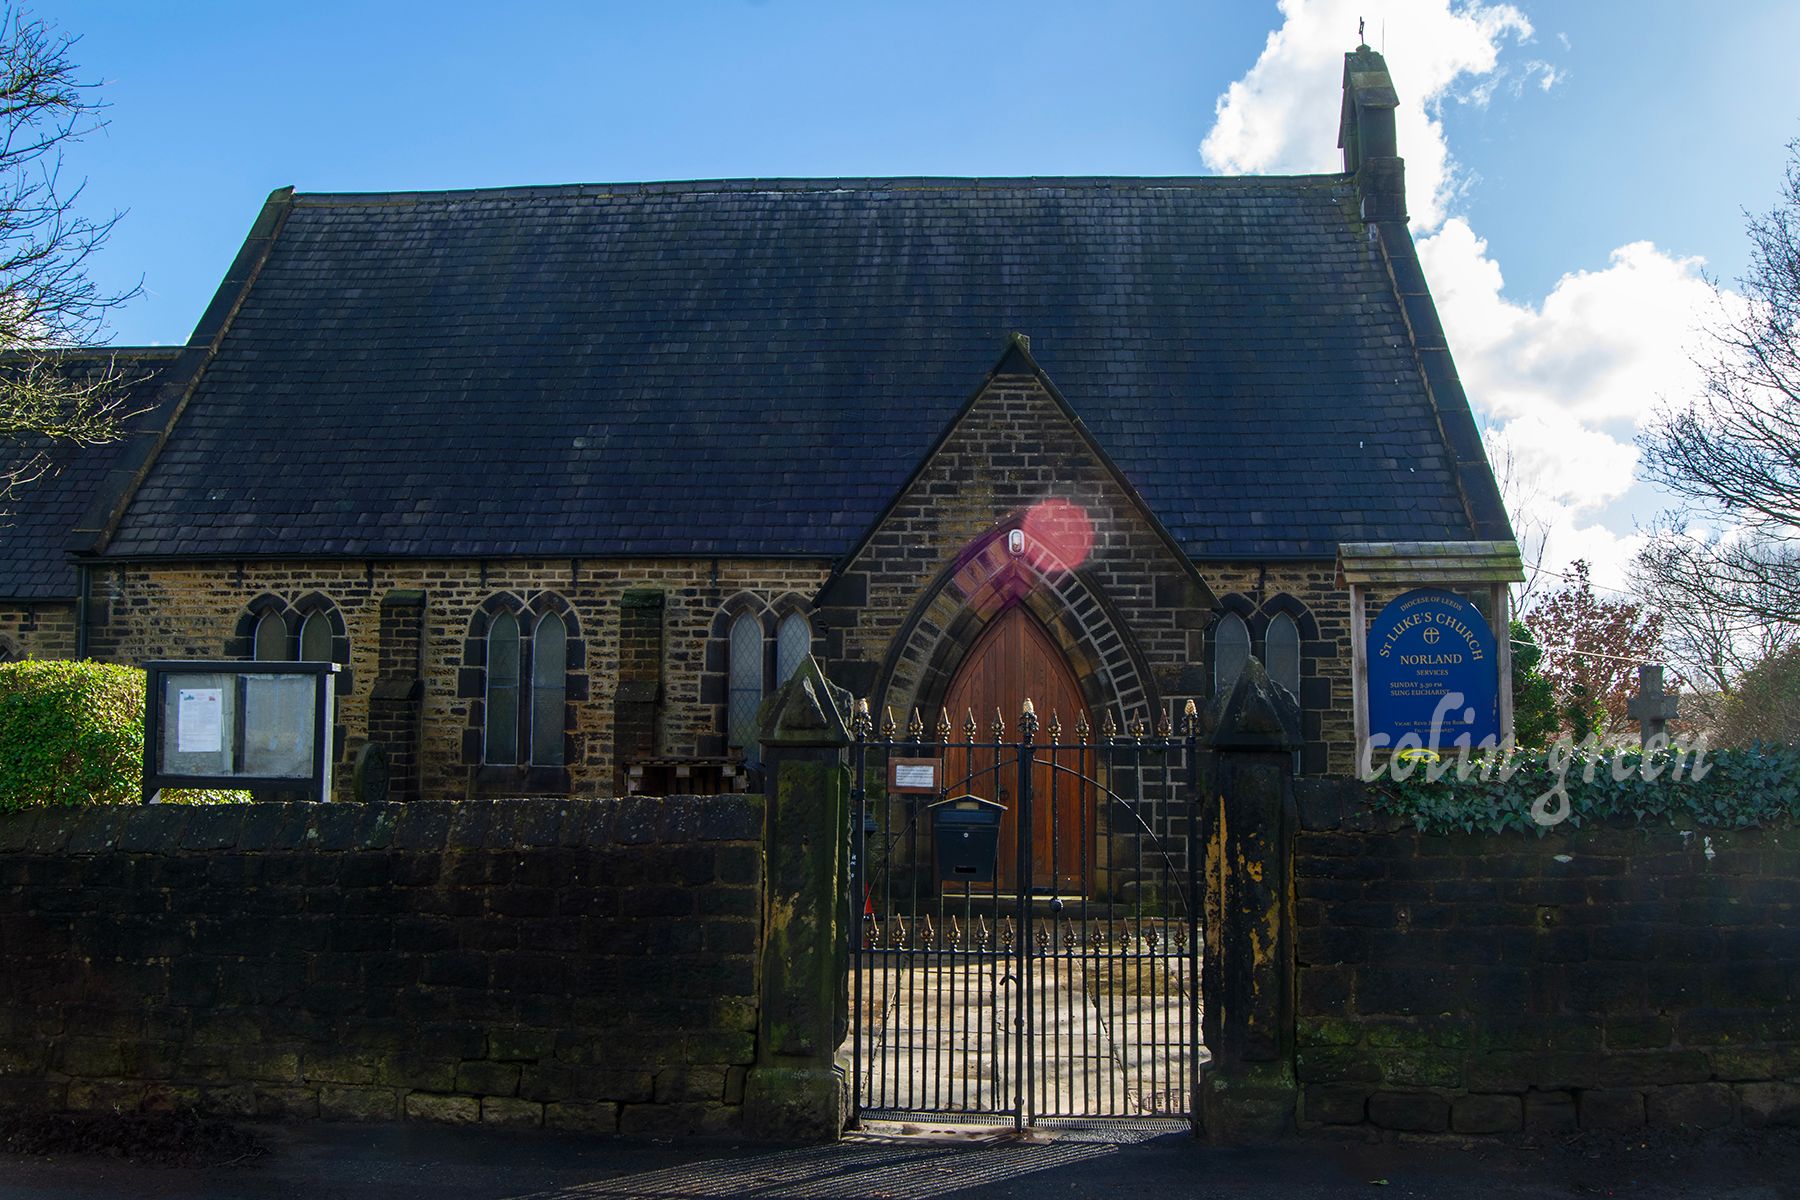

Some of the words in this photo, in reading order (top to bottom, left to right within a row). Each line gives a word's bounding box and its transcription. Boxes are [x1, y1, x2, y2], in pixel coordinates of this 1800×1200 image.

[1400, 596, 1431, 611] DIOCESE
[1441, 598, 1463, 611] LEEDS
[1387, 612, 1433, 642] LUKE'S
[1436, 613, 1484, 660] CHURCH
[1400, 653, 1463, 665] NORLAND
